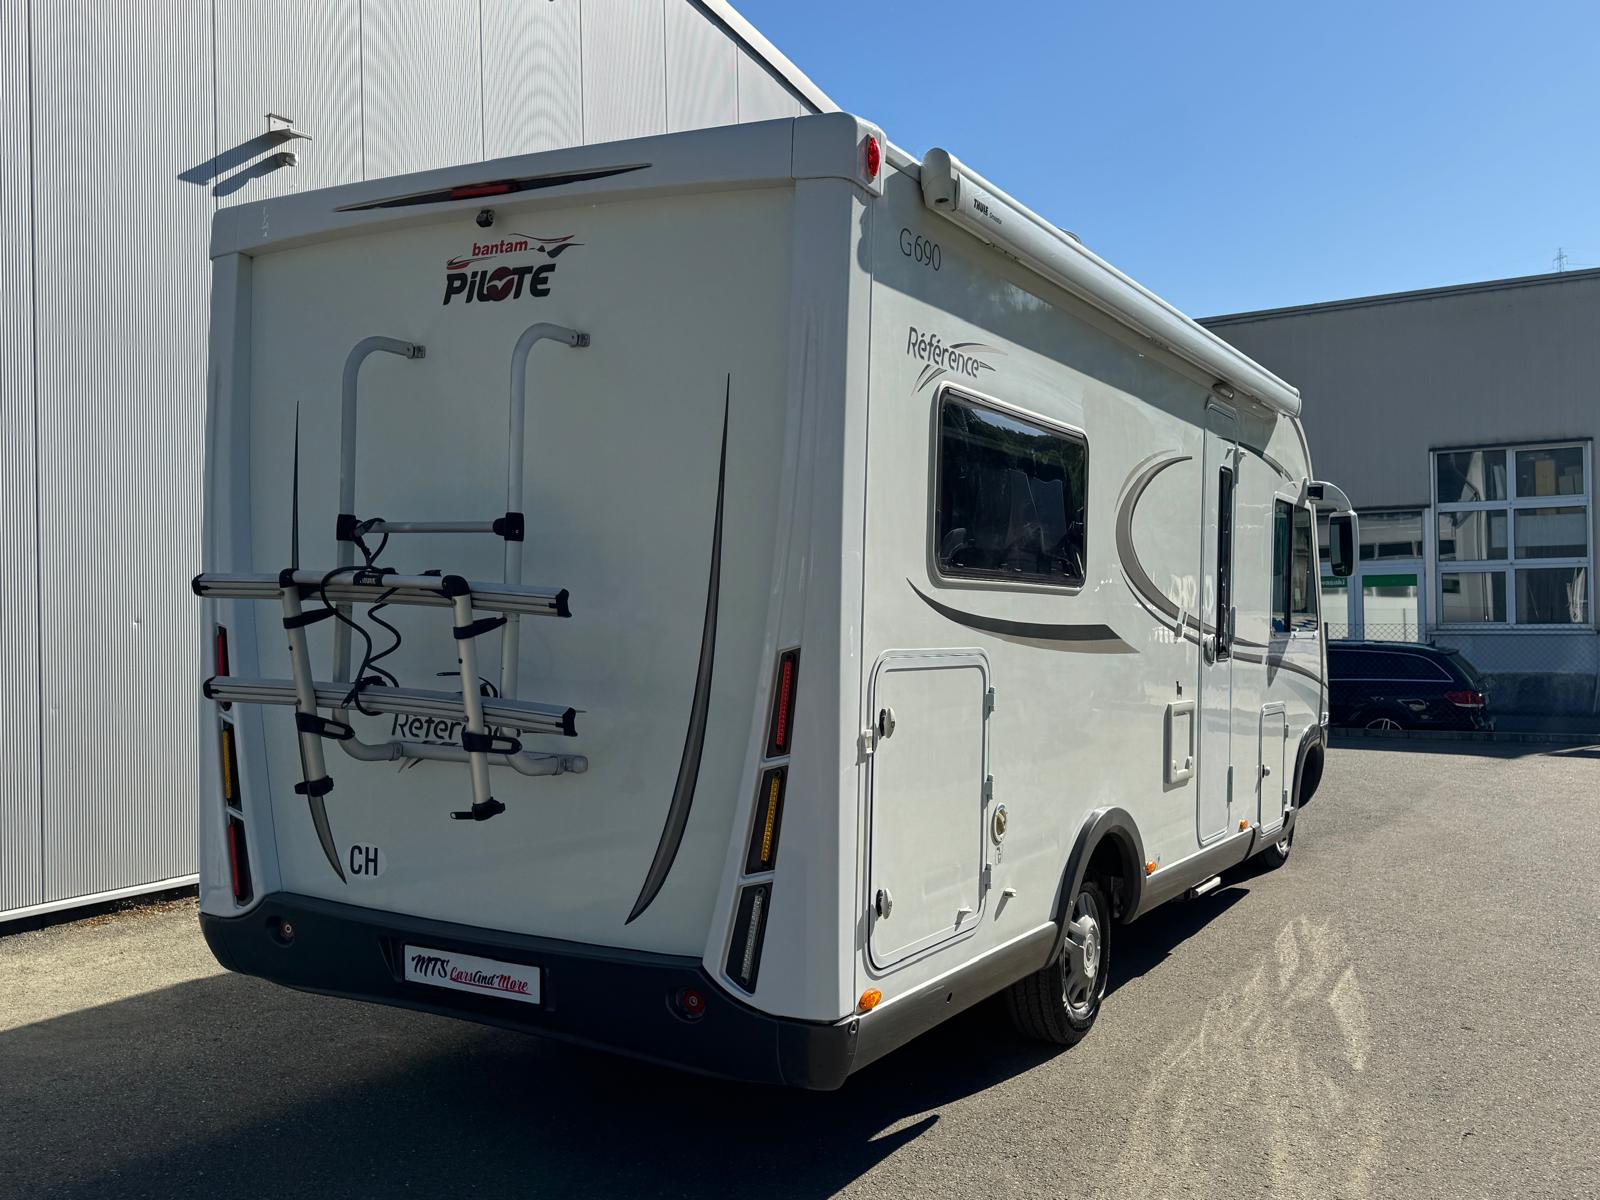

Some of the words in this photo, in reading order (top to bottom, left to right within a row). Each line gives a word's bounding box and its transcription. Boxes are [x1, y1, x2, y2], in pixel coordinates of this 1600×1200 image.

[472, 239, 528, 257] bantam
[899, 227, 942, 272] G690
[907, 326, 980, 379] Référence
[350, 844, 379, 877] CH
[411, 953, 450, 979] MTS
